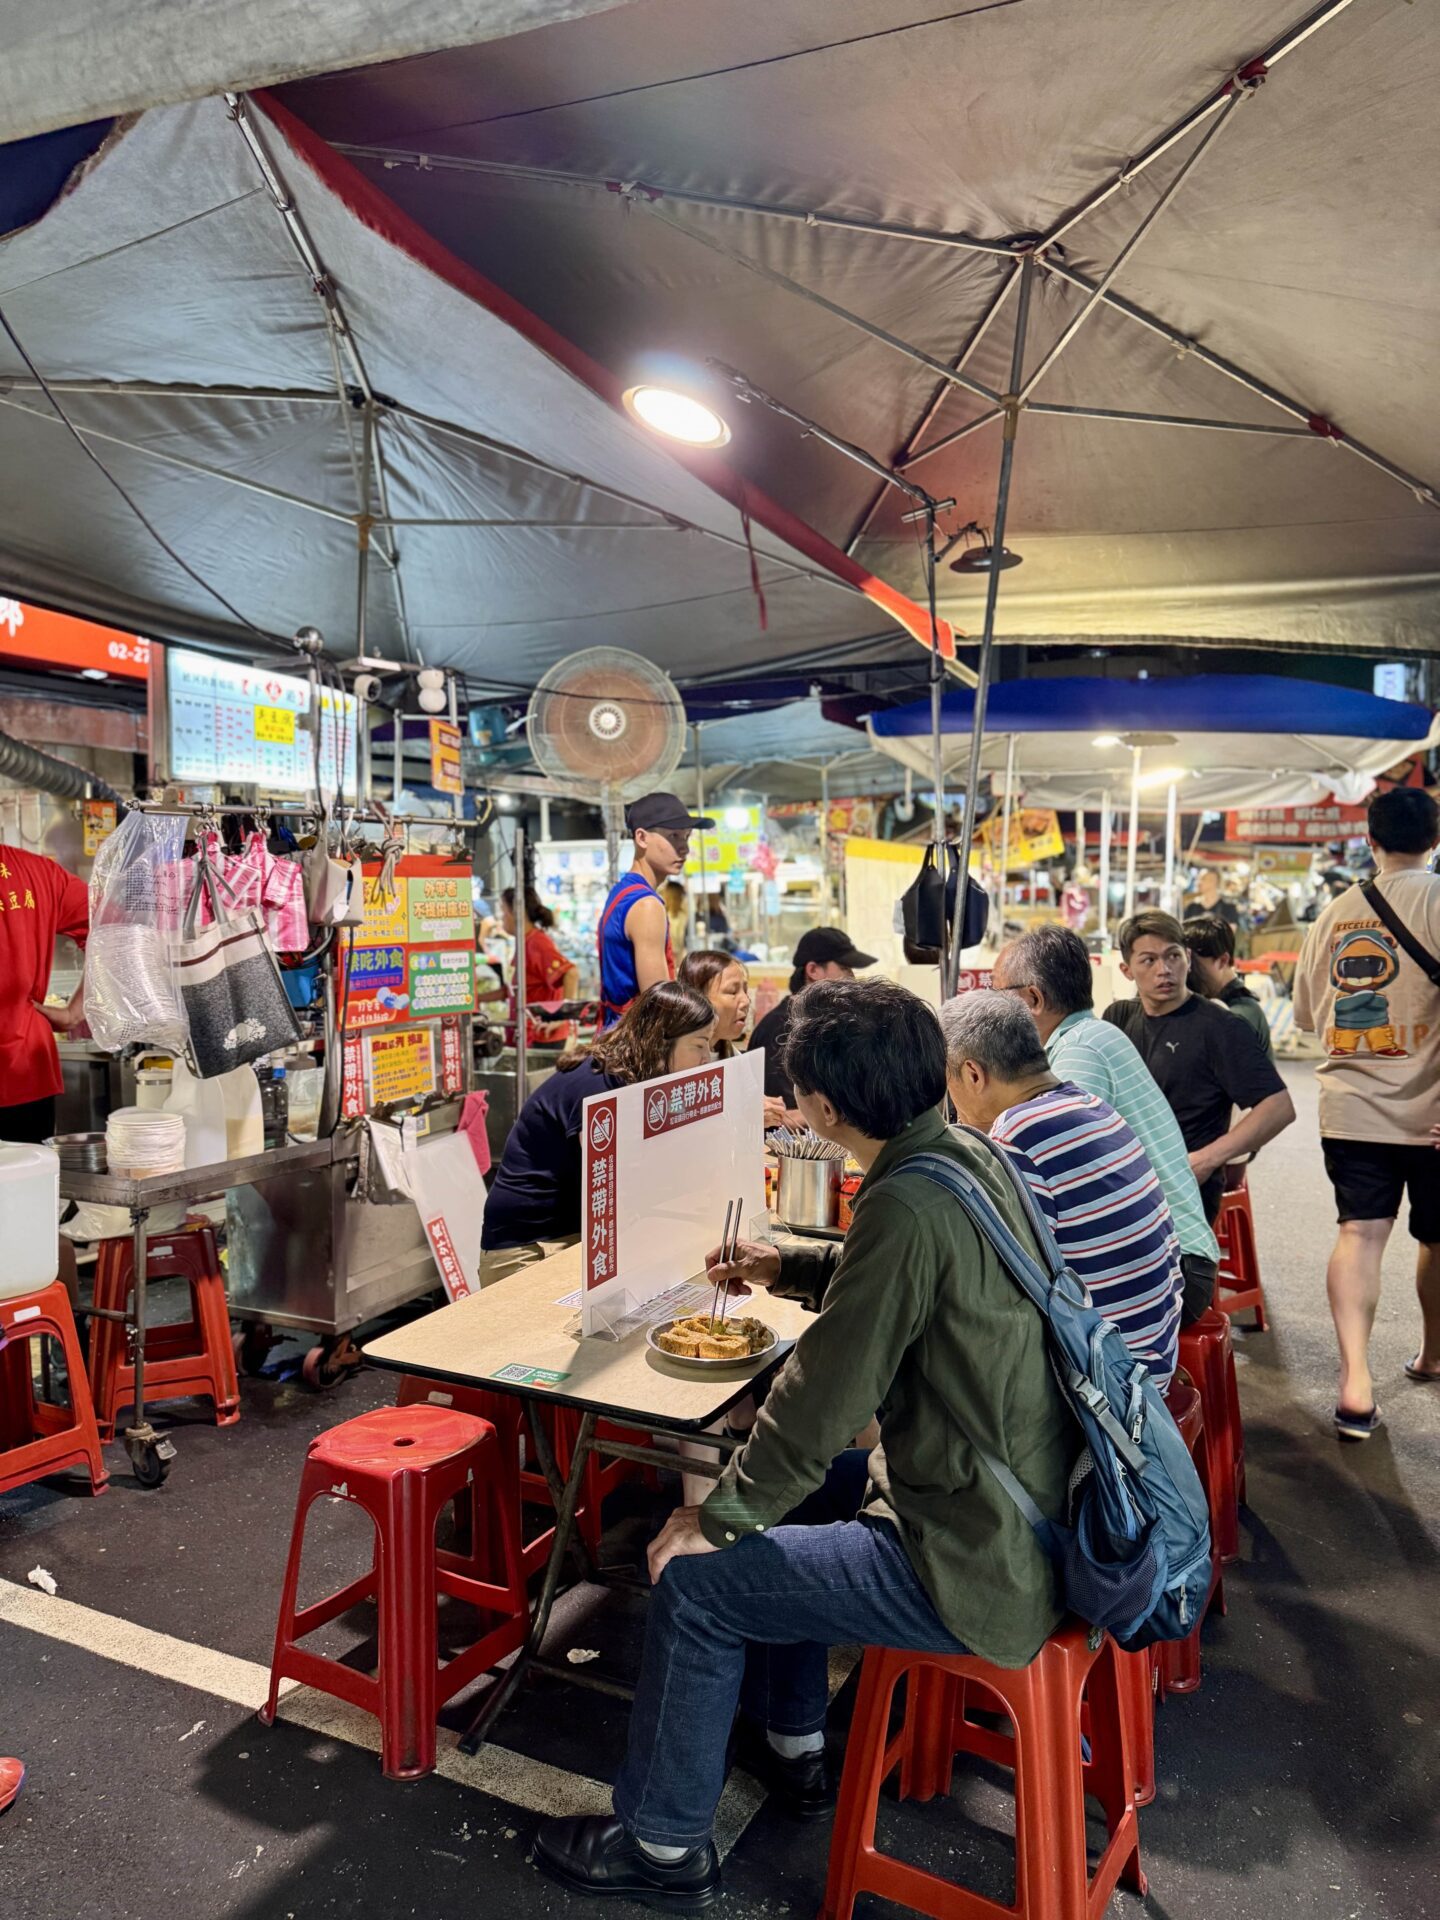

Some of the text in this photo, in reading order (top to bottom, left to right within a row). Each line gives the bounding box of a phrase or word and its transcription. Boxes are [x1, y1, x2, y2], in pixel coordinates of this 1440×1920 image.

[344, 1045, 359, 1116] 禁帶外食
[443, 1028, 457, 1092] 禁帶外食
[669, 1074, 722, 1113] 禁帶外食
[592, 1157, 608, 1282] 禁帶外食
[432, 1222, 461, 1289] 禁帶外食
